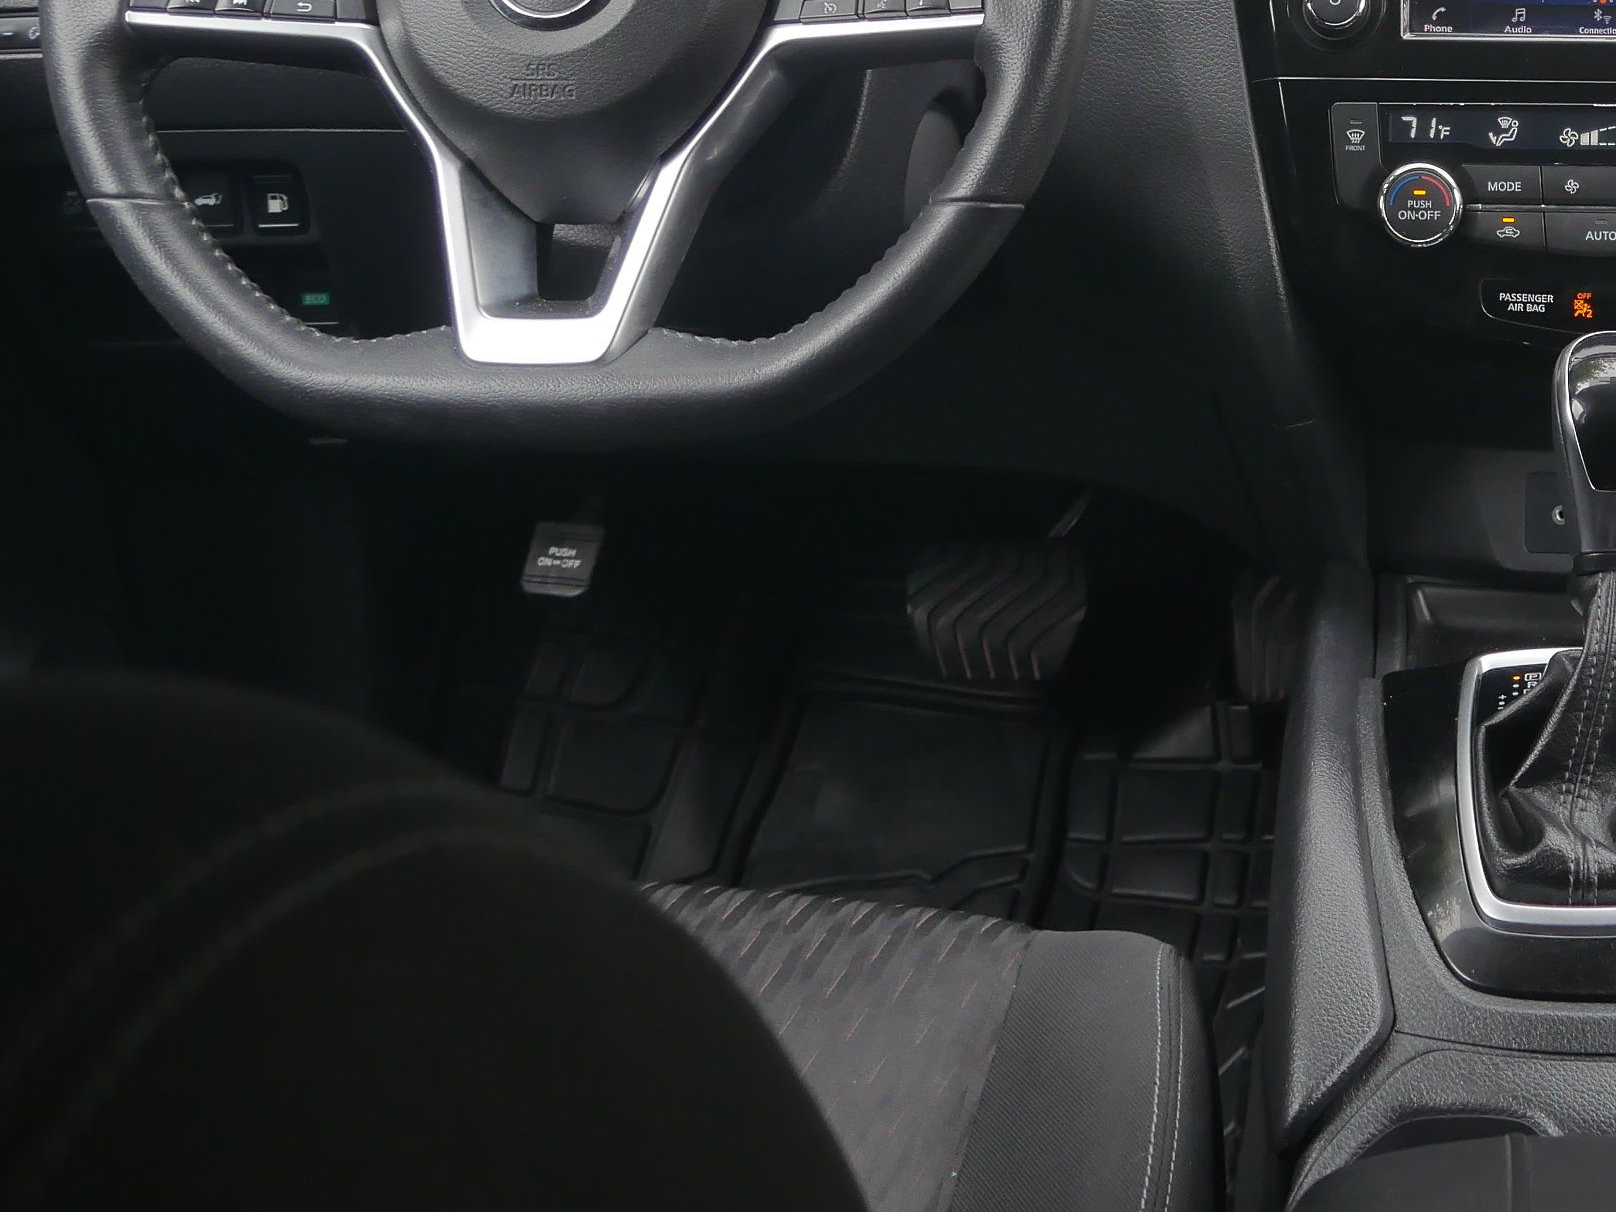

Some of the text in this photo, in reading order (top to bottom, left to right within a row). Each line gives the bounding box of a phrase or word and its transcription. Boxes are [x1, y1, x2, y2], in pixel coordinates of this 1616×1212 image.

[1424, 24, 1453, 34] Phone
[1504, 25, 1532, 35] Audio
[509, 83, 577, 100] AIRBAG
[1345, 144, 1366, 152] FRONT
[1487, 180, 1523, 193] MODE
[1407, 200, 1432, 210] PUSH
[1499, 292, 1554, 304] PASSENGER
[1576, 292, 1593, 300] OFF
[1507, 302, 1546, 313] AIR BAG
[548, 546, 578, 557] PUSH
